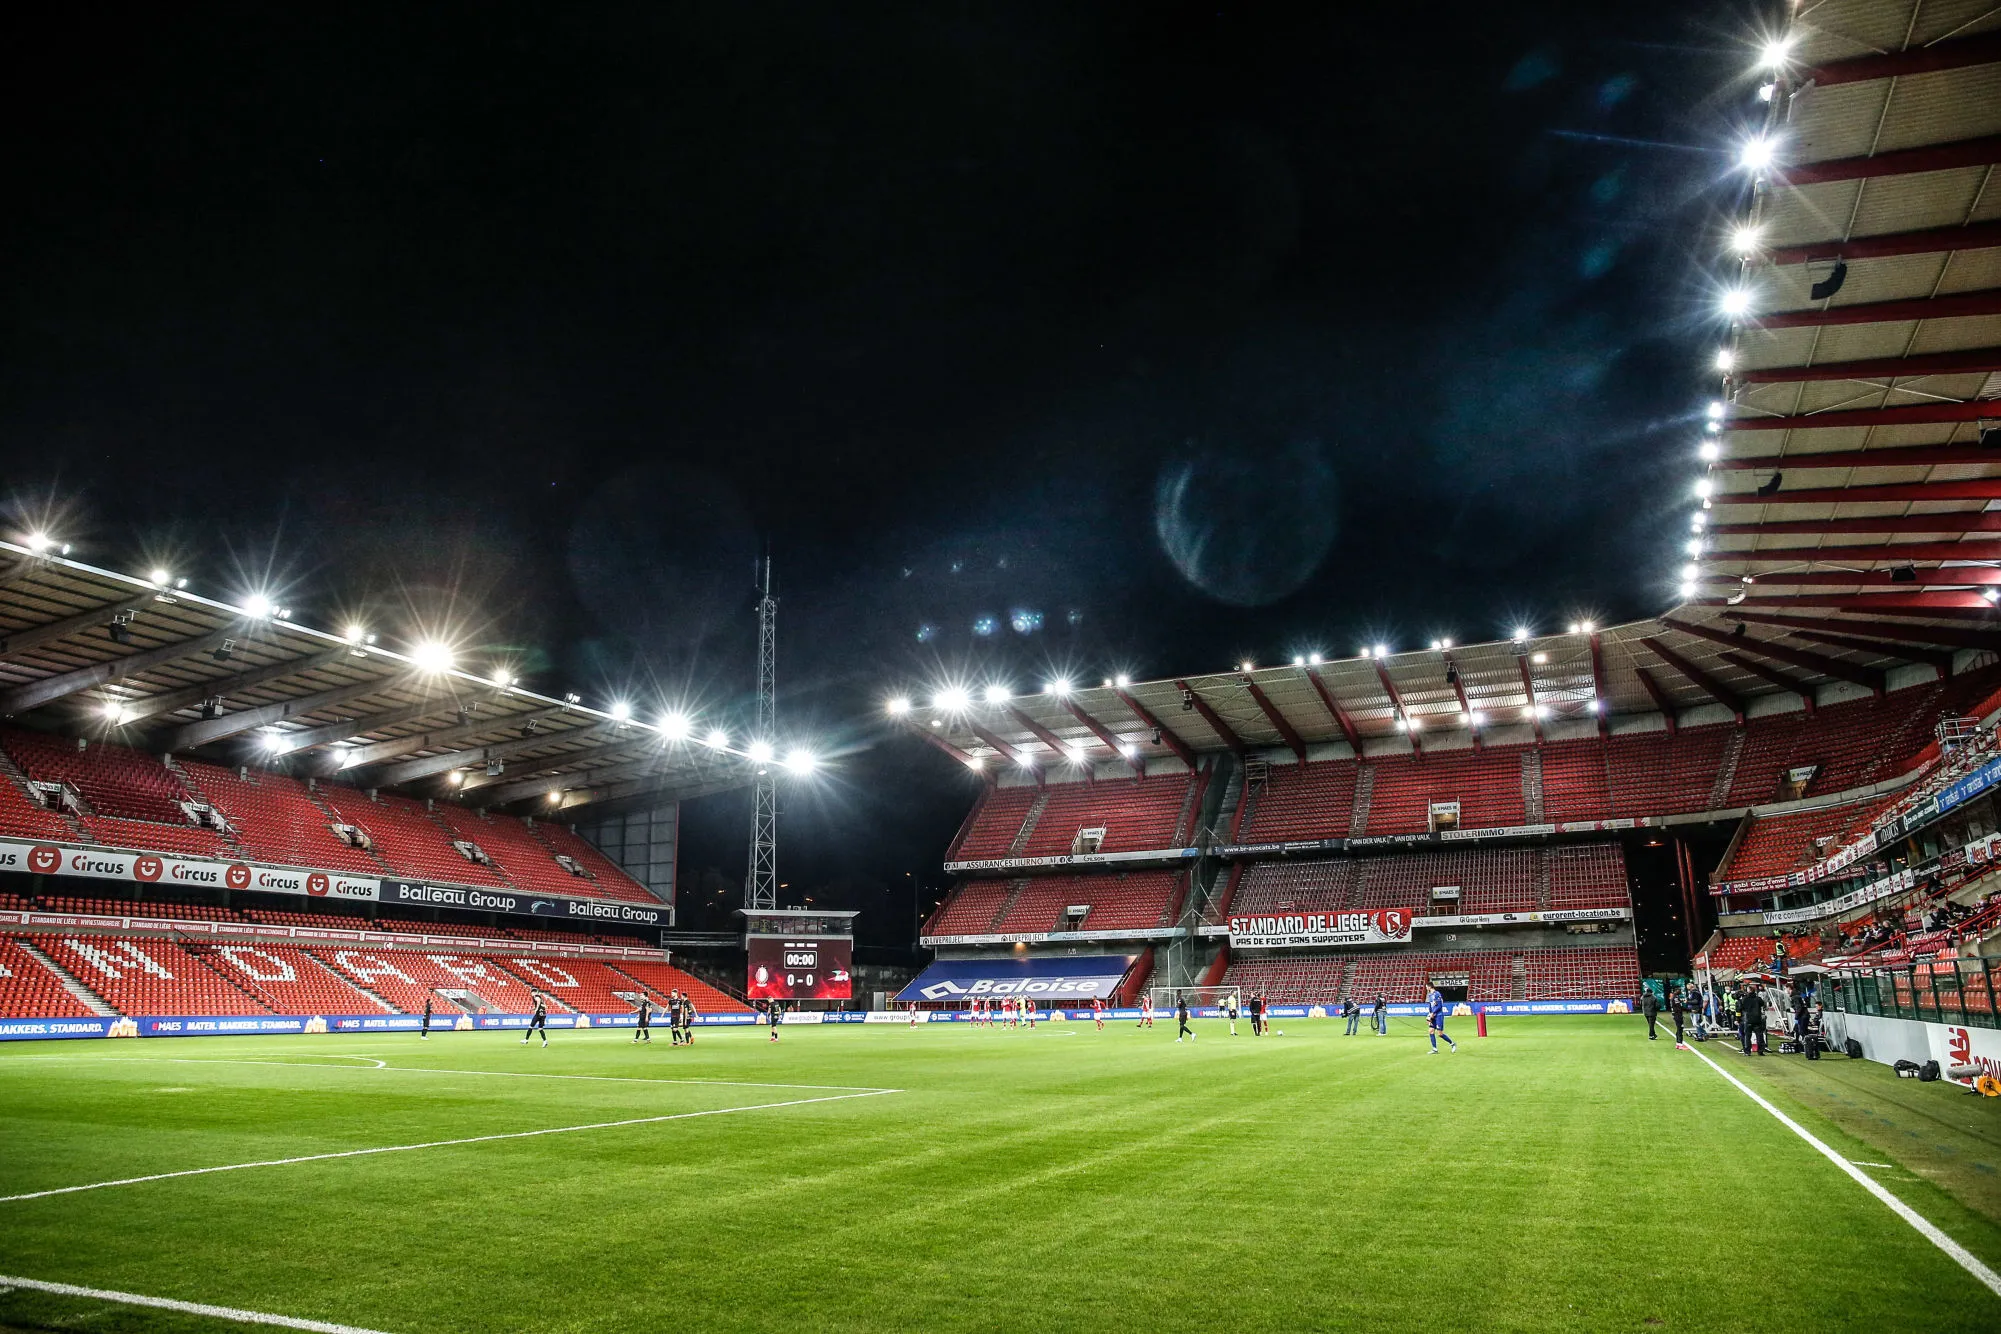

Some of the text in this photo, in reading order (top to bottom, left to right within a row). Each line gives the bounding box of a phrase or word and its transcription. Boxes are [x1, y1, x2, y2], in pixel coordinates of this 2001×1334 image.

[1442, 828, 1505, 840] STOLERIMMO
[72, 855, 124, 874] Circus
[966, 859, 1012, 869] ASSURANCES
[171, 864, 217, 882] Circus
[258, 872, 299, 890] Circus
[335, 880, 372, 896] Circus
[469, 891, 516, 911] Group
[31, 916, 56, 925] STANDARD
[56, 917, 62, 925] DE
[622, 906, 658, 924] Group
[1542, 910, 1620, 920] eurorent-location.be
[1231, 913, 1369, 935] STANDARD DE LIEGE
[930, 935, 964, 944] LIVEPROJECT
[1009, 933, 1044, 942] LIVEPROJECT
[1236, 934, 1366, 946] PAS DE FOOT SANS SUPPORTERS
[786, 954, 814, 966] 00:00
[787, 974, 794, 986] 0
[806, 974, 814, 986] 0
[967, 977, 1099, 994] Baloise
[50, 1023, 104, 1034] STANDARD.
[261, 1020, 302, 1030] STANDARD.
